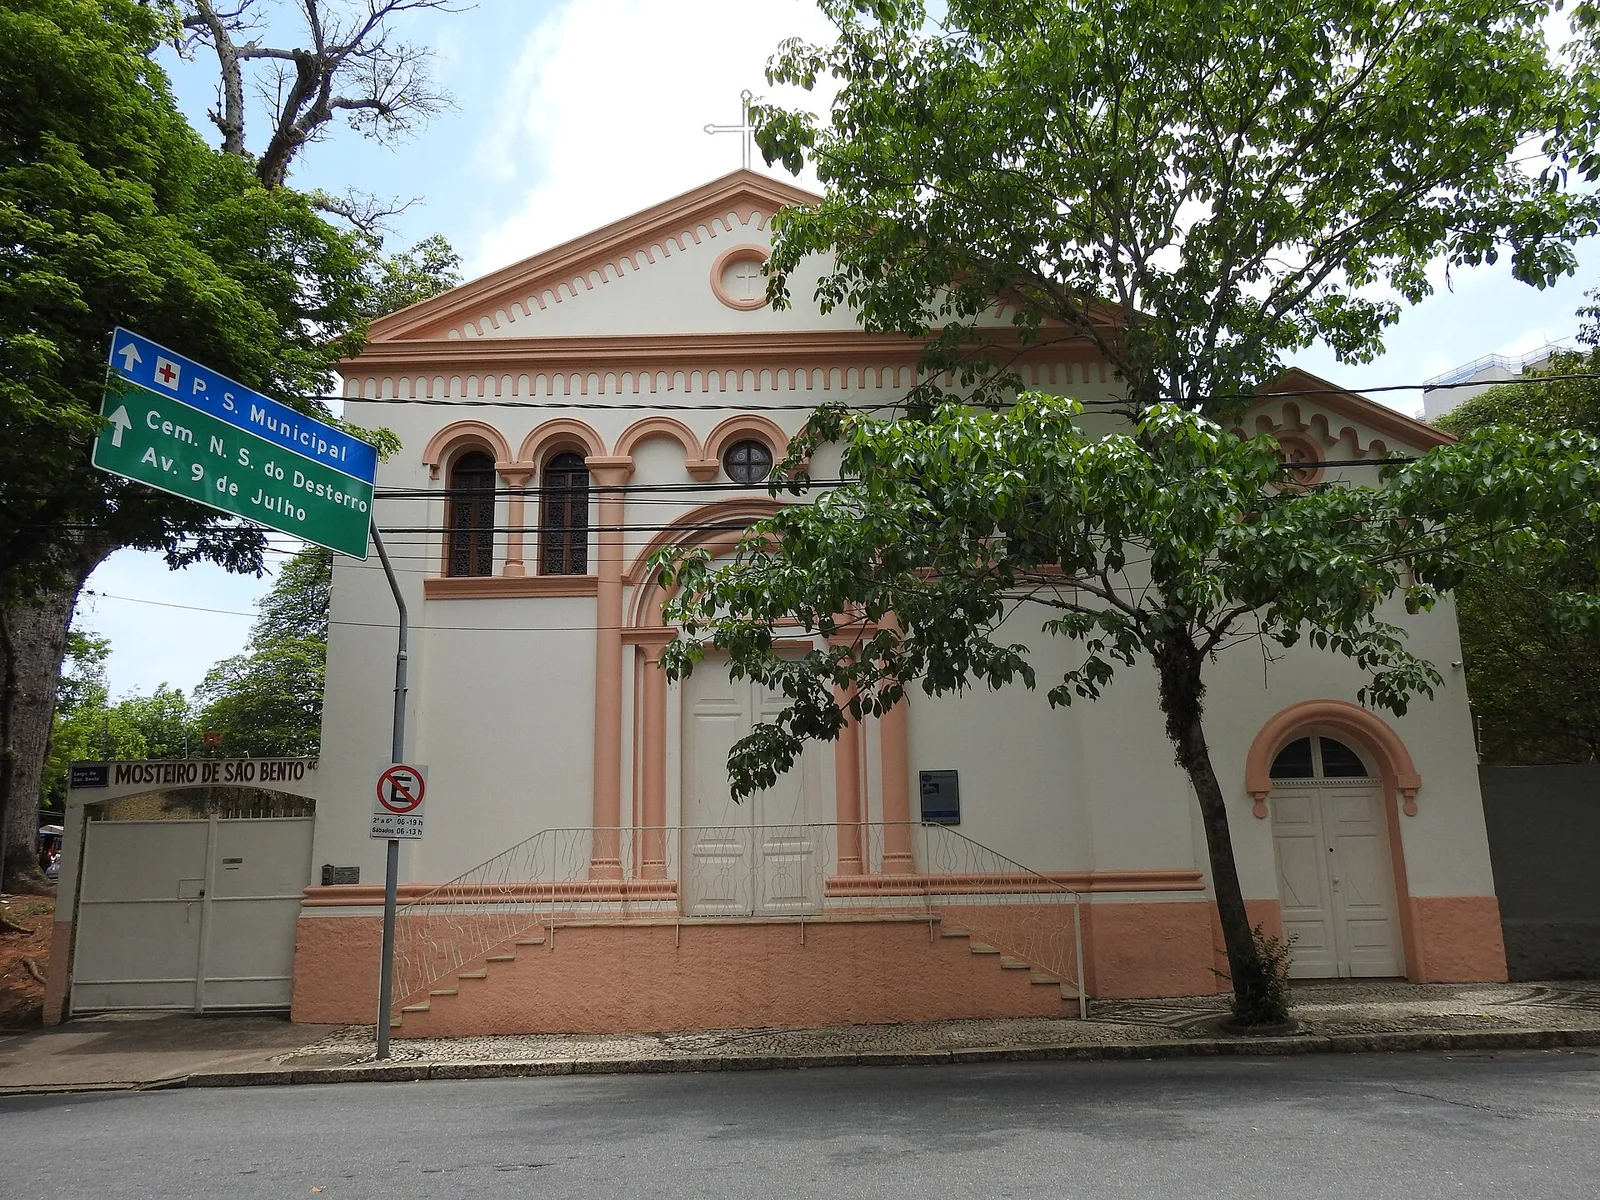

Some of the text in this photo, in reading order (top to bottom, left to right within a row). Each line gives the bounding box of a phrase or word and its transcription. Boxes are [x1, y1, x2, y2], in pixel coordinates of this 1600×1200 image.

[191, 376, 347, 462] P. S. Municipal
[140, 446, 307, 521] Av. 9 de Julho
[146, 410, 368, 513] Cem. N. S. do Desterro
[114, 762, 198, 785] MOSTEIRO
[201, 762, 220, 783] DE
[224, 760, 256, 783] SÃO
[259, 761, 305, 782] BENTO
